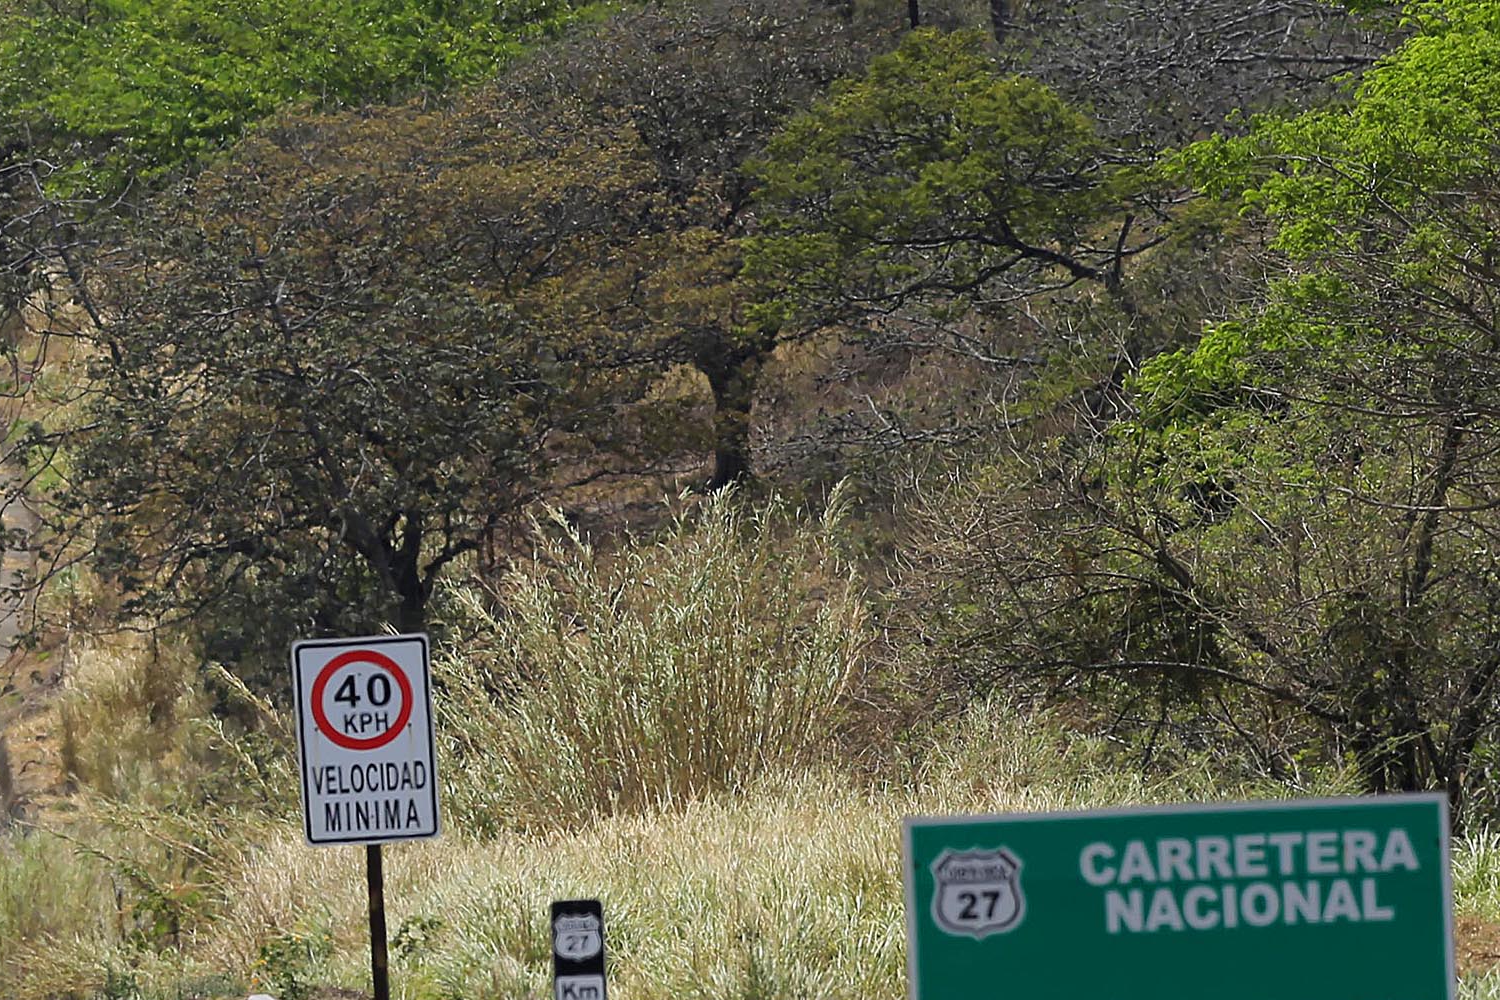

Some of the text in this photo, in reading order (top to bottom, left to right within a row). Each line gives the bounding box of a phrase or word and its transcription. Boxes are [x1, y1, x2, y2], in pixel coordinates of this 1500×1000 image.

[334, 673, 392, 708] 40
[343, 711, 389, 734] KPH
[311, 760, 426, 795] VELOCIDAD
[325, 798, 420, 832] MINIMA
[1079, 828, 1420, 886] CARRETERA
[958, 891, 1000, 920] 27
[1105, 879, 1395, 934] NACIONAL
[566, 935, 589, 951] 27
[562, 983, 599, 1000] Km
